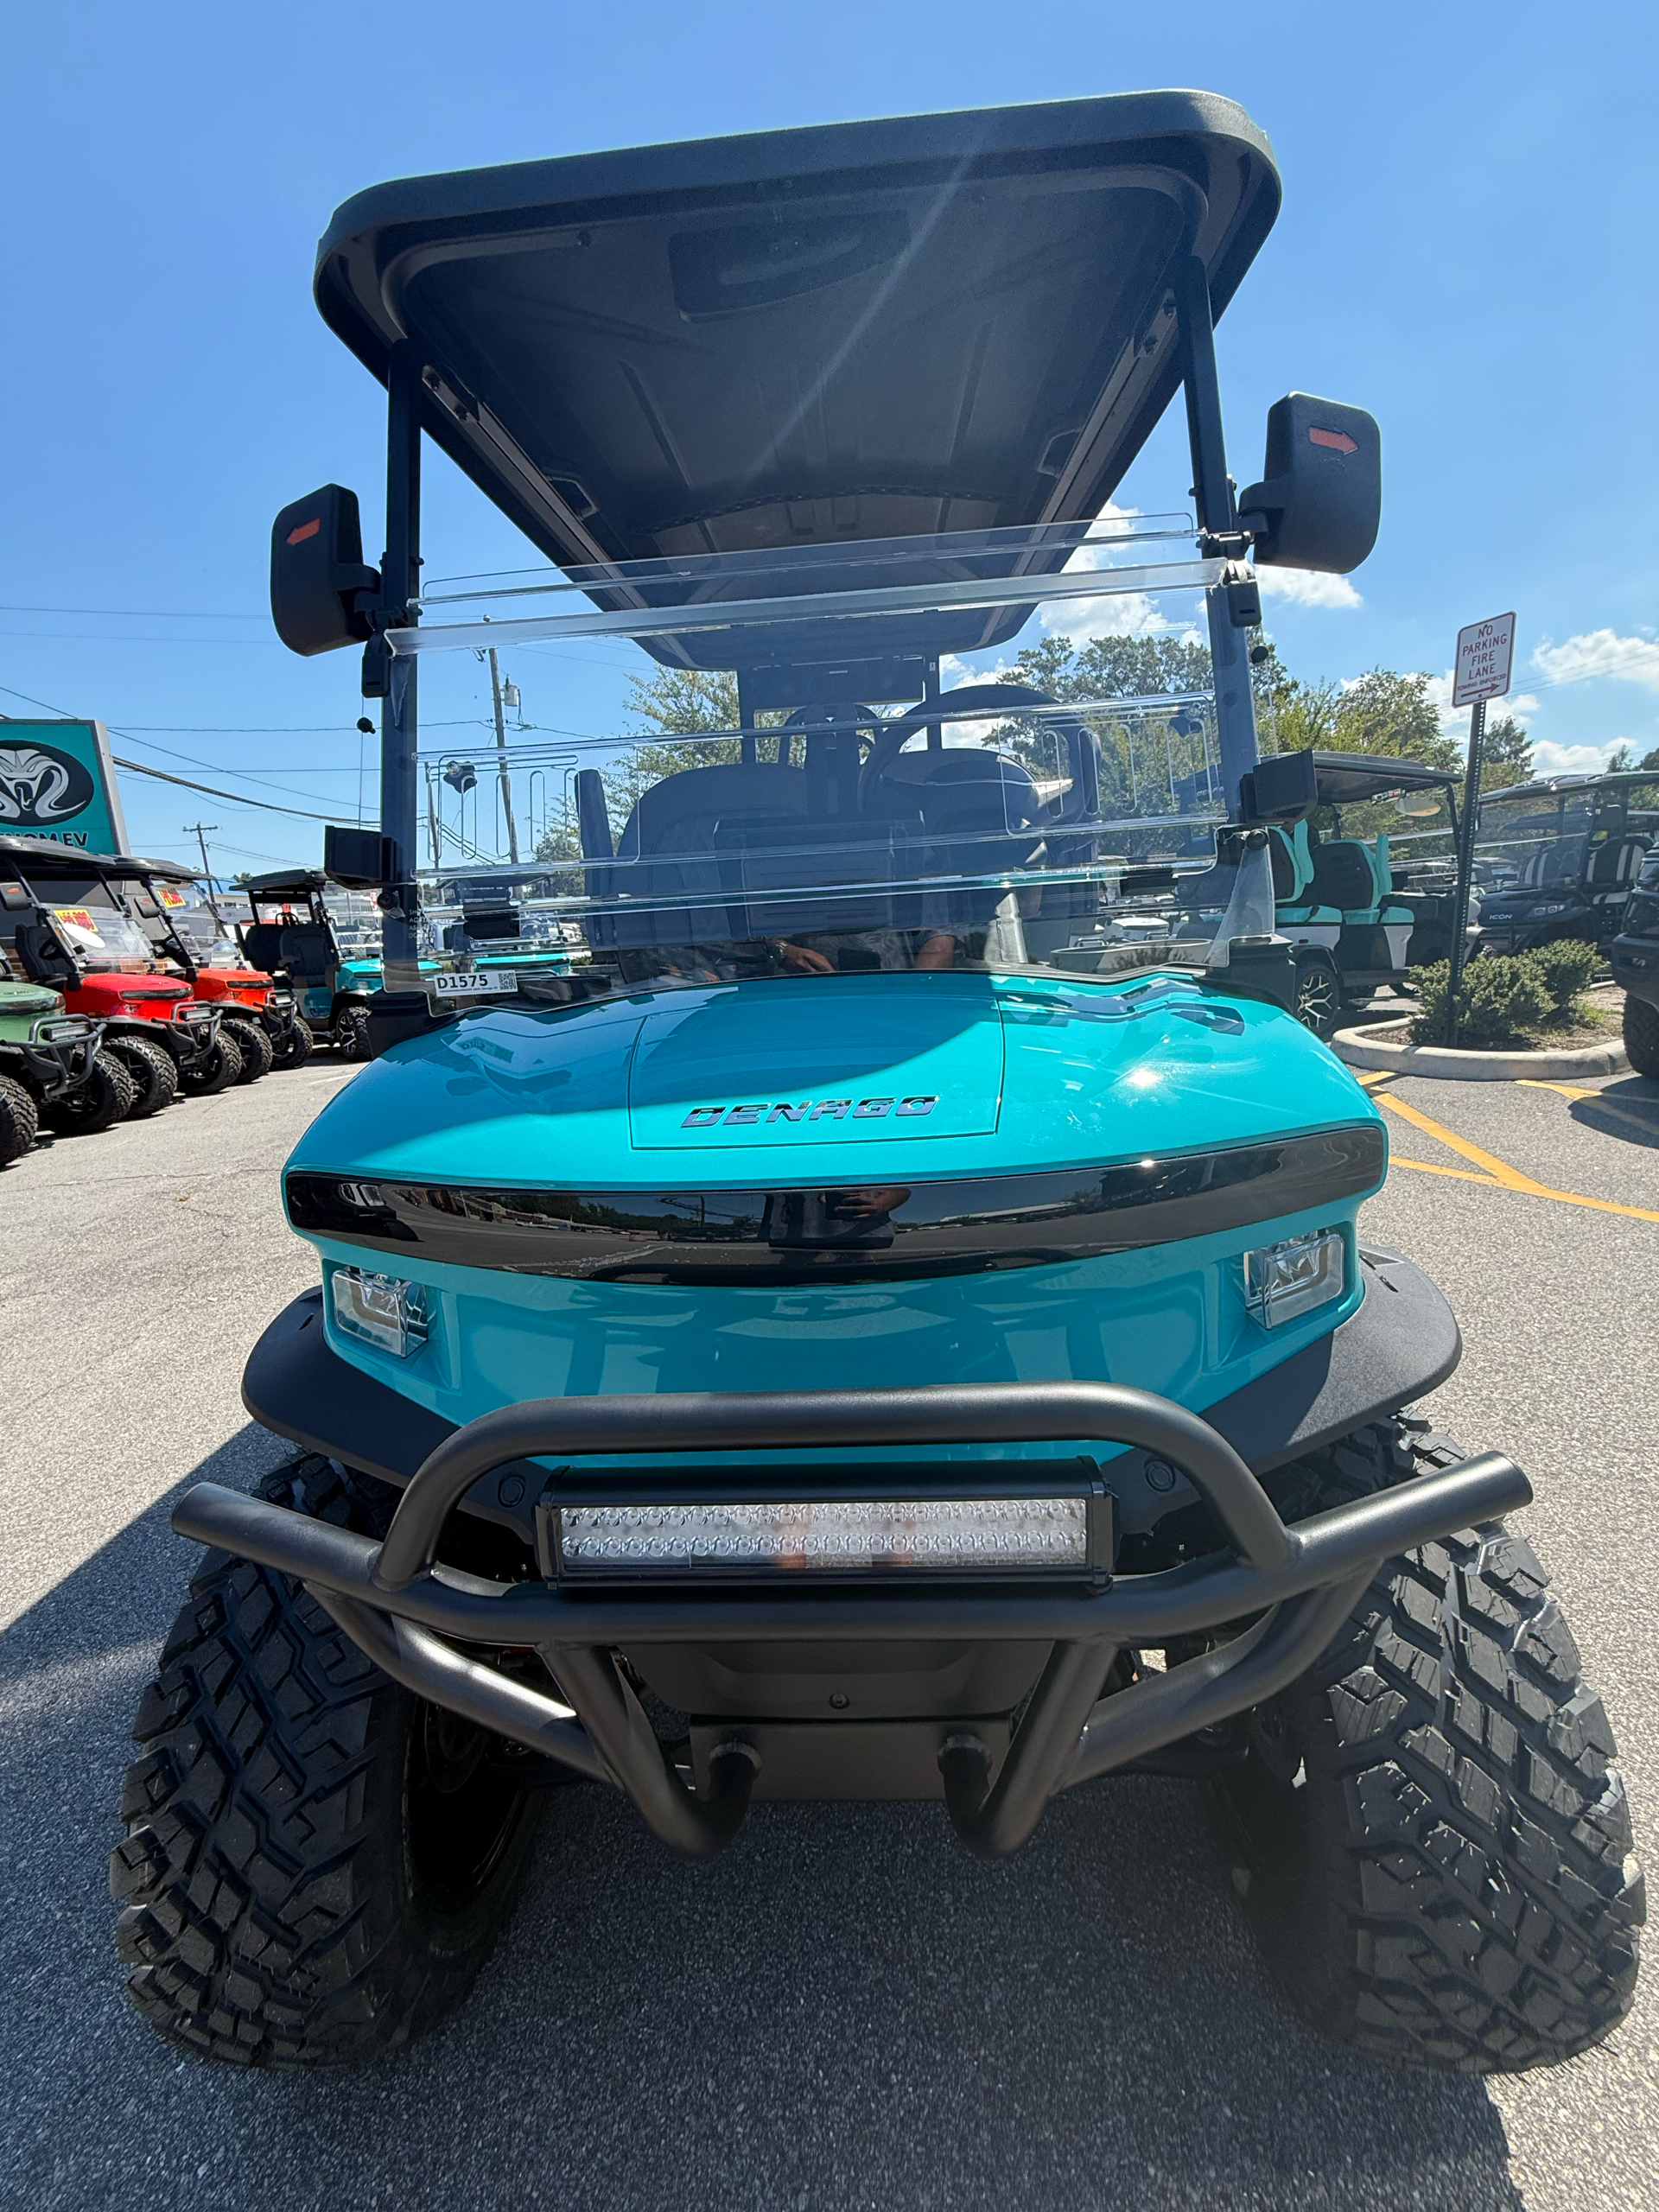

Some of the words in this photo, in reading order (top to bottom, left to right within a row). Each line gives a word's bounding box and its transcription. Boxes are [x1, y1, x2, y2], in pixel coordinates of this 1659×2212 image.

[1478, 625, 1493, 639] NO
[1462, 633, 1507, 657] PARKING
[1471, 650, 1495, 666] FIRE
[1469, 663, 1496, 680] LANE
[1457, 682, 1478, 691] TOWING
[1479, 673, 1507, 685] ENFORCED
[62, 832, 88, 847] EV
[436, 974, 488, 989] D1575
[679, 1095, 939, 1128] DENAGO
